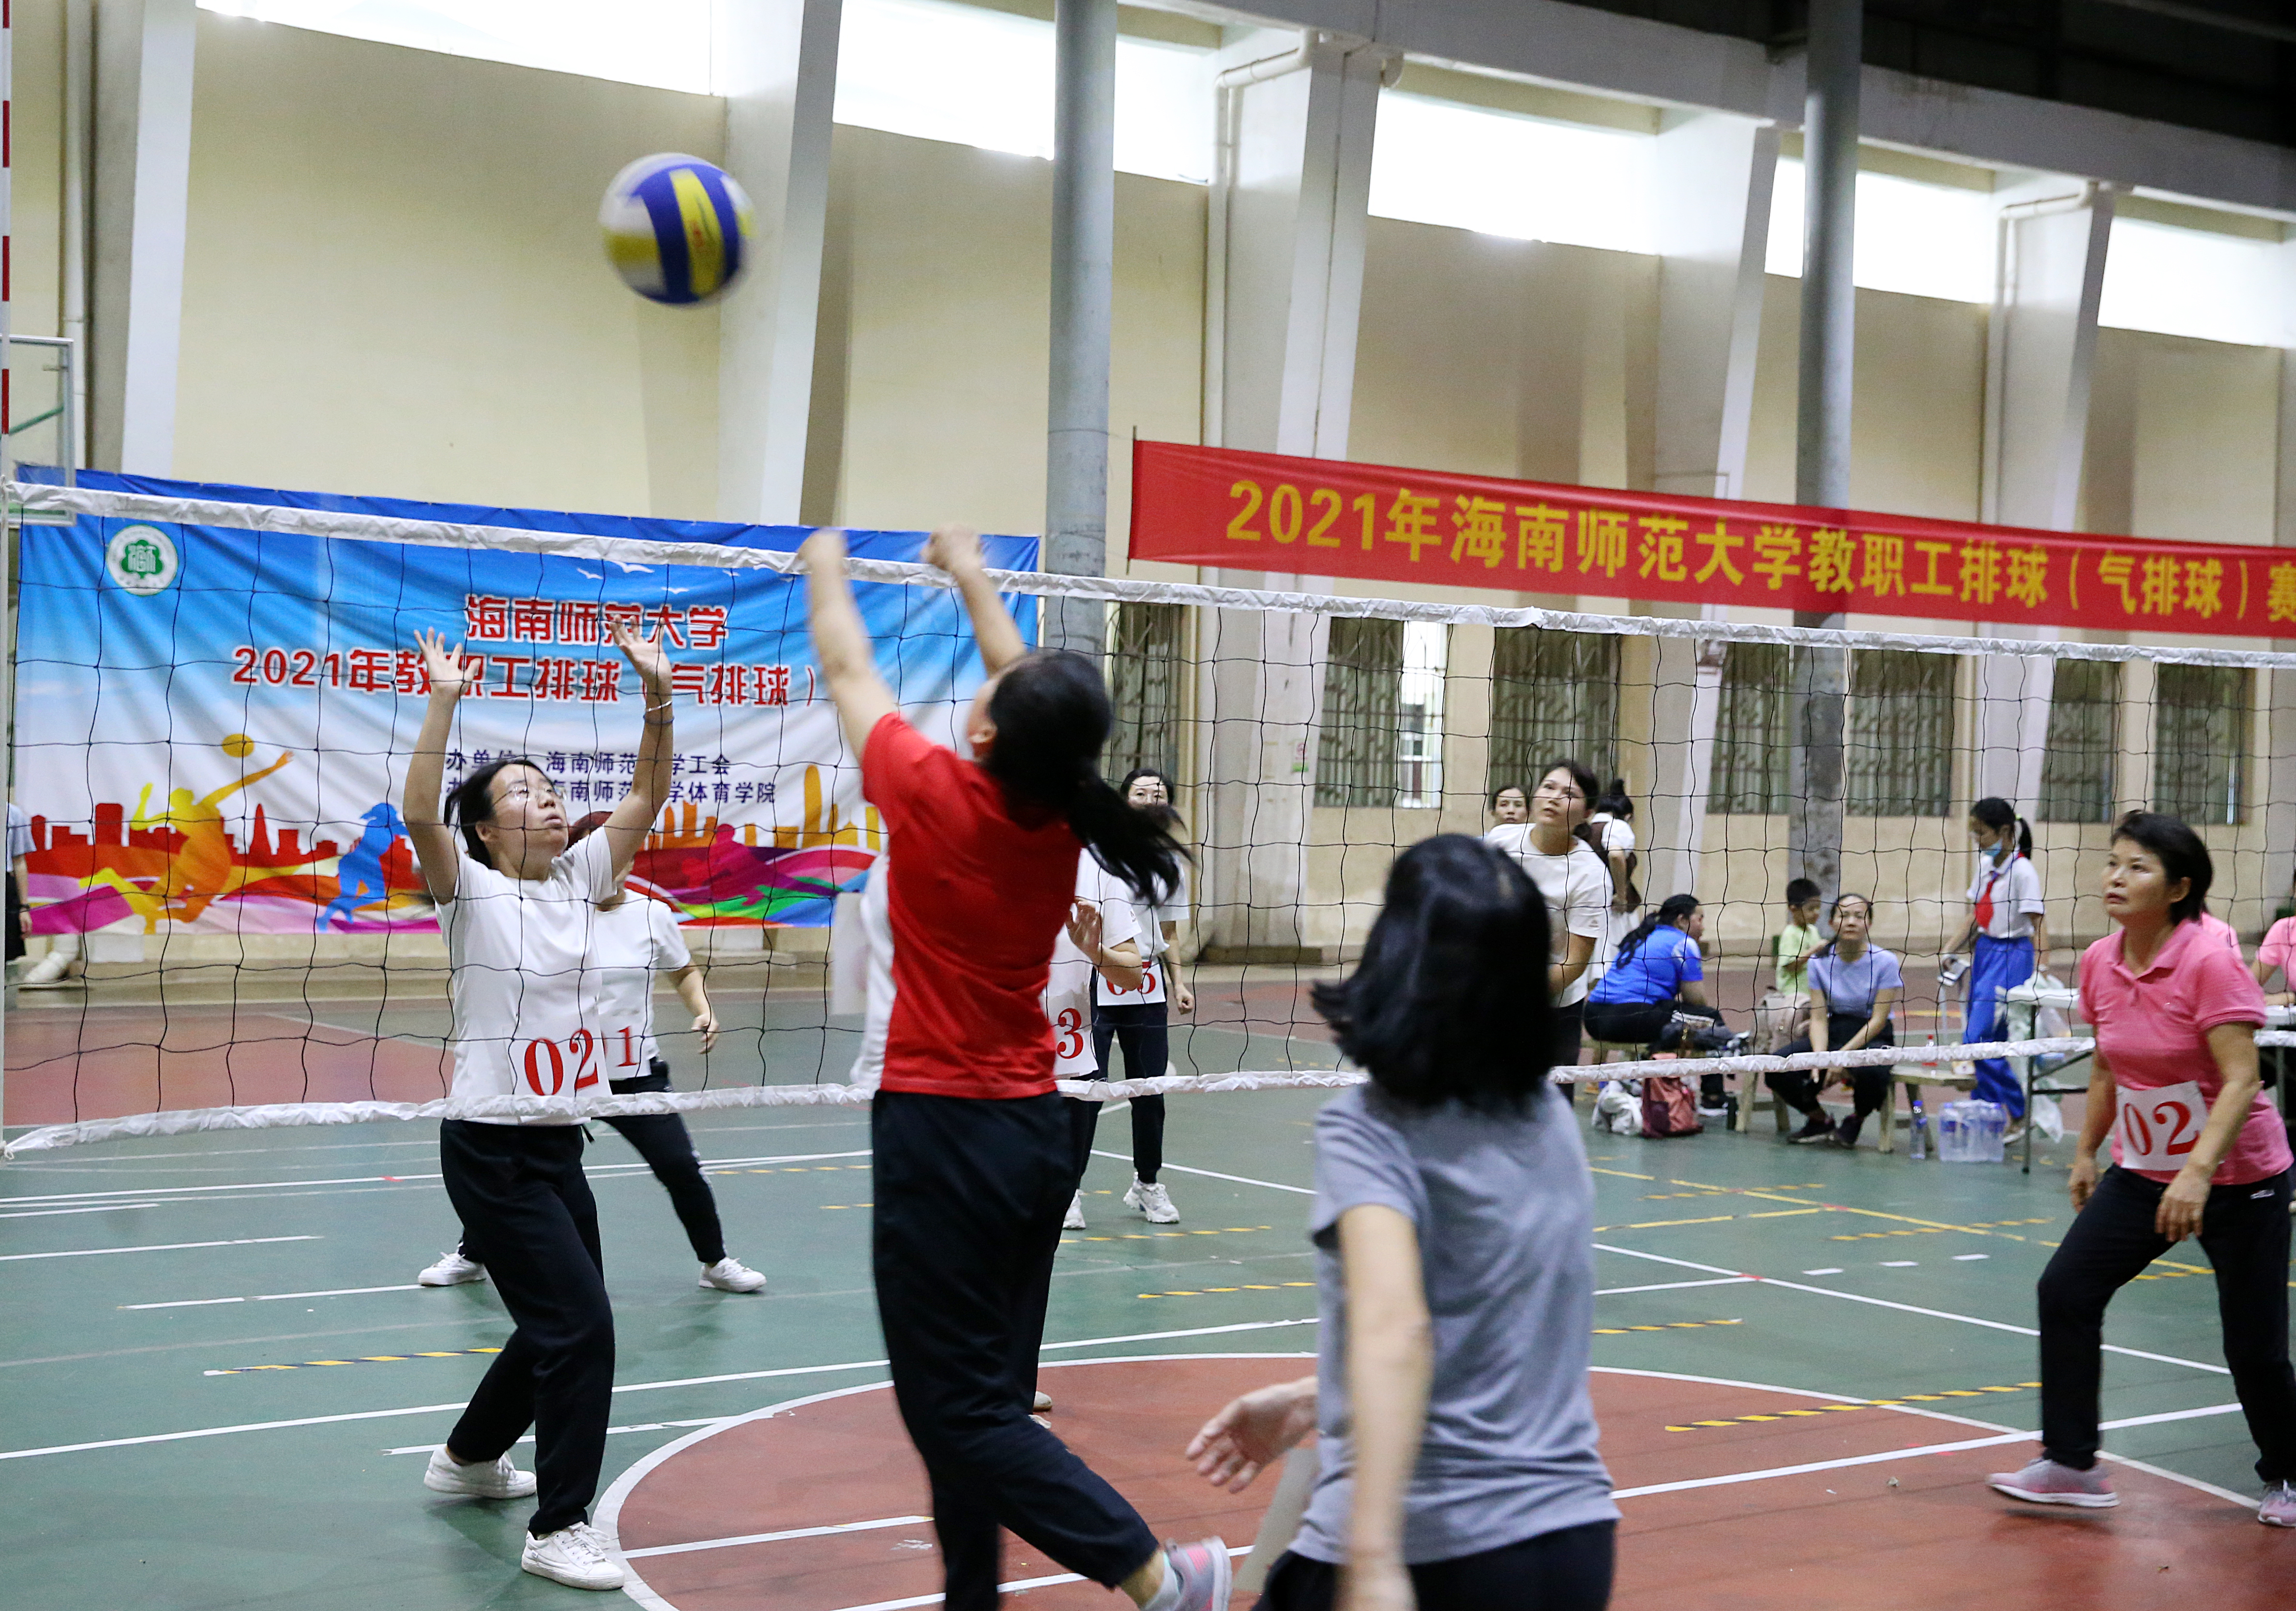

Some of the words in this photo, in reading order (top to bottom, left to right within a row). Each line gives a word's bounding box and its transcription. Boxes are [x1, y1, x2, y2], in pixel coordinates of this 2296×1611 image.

[467, 595, 727, 648] 海南师范大学
[1106, 961, 1156, 995] 5
[524, 1028, 599, 1096] 02
[601, 1026, 639, 1067] 1
[2123, 1100, 2200, 1156] 02
